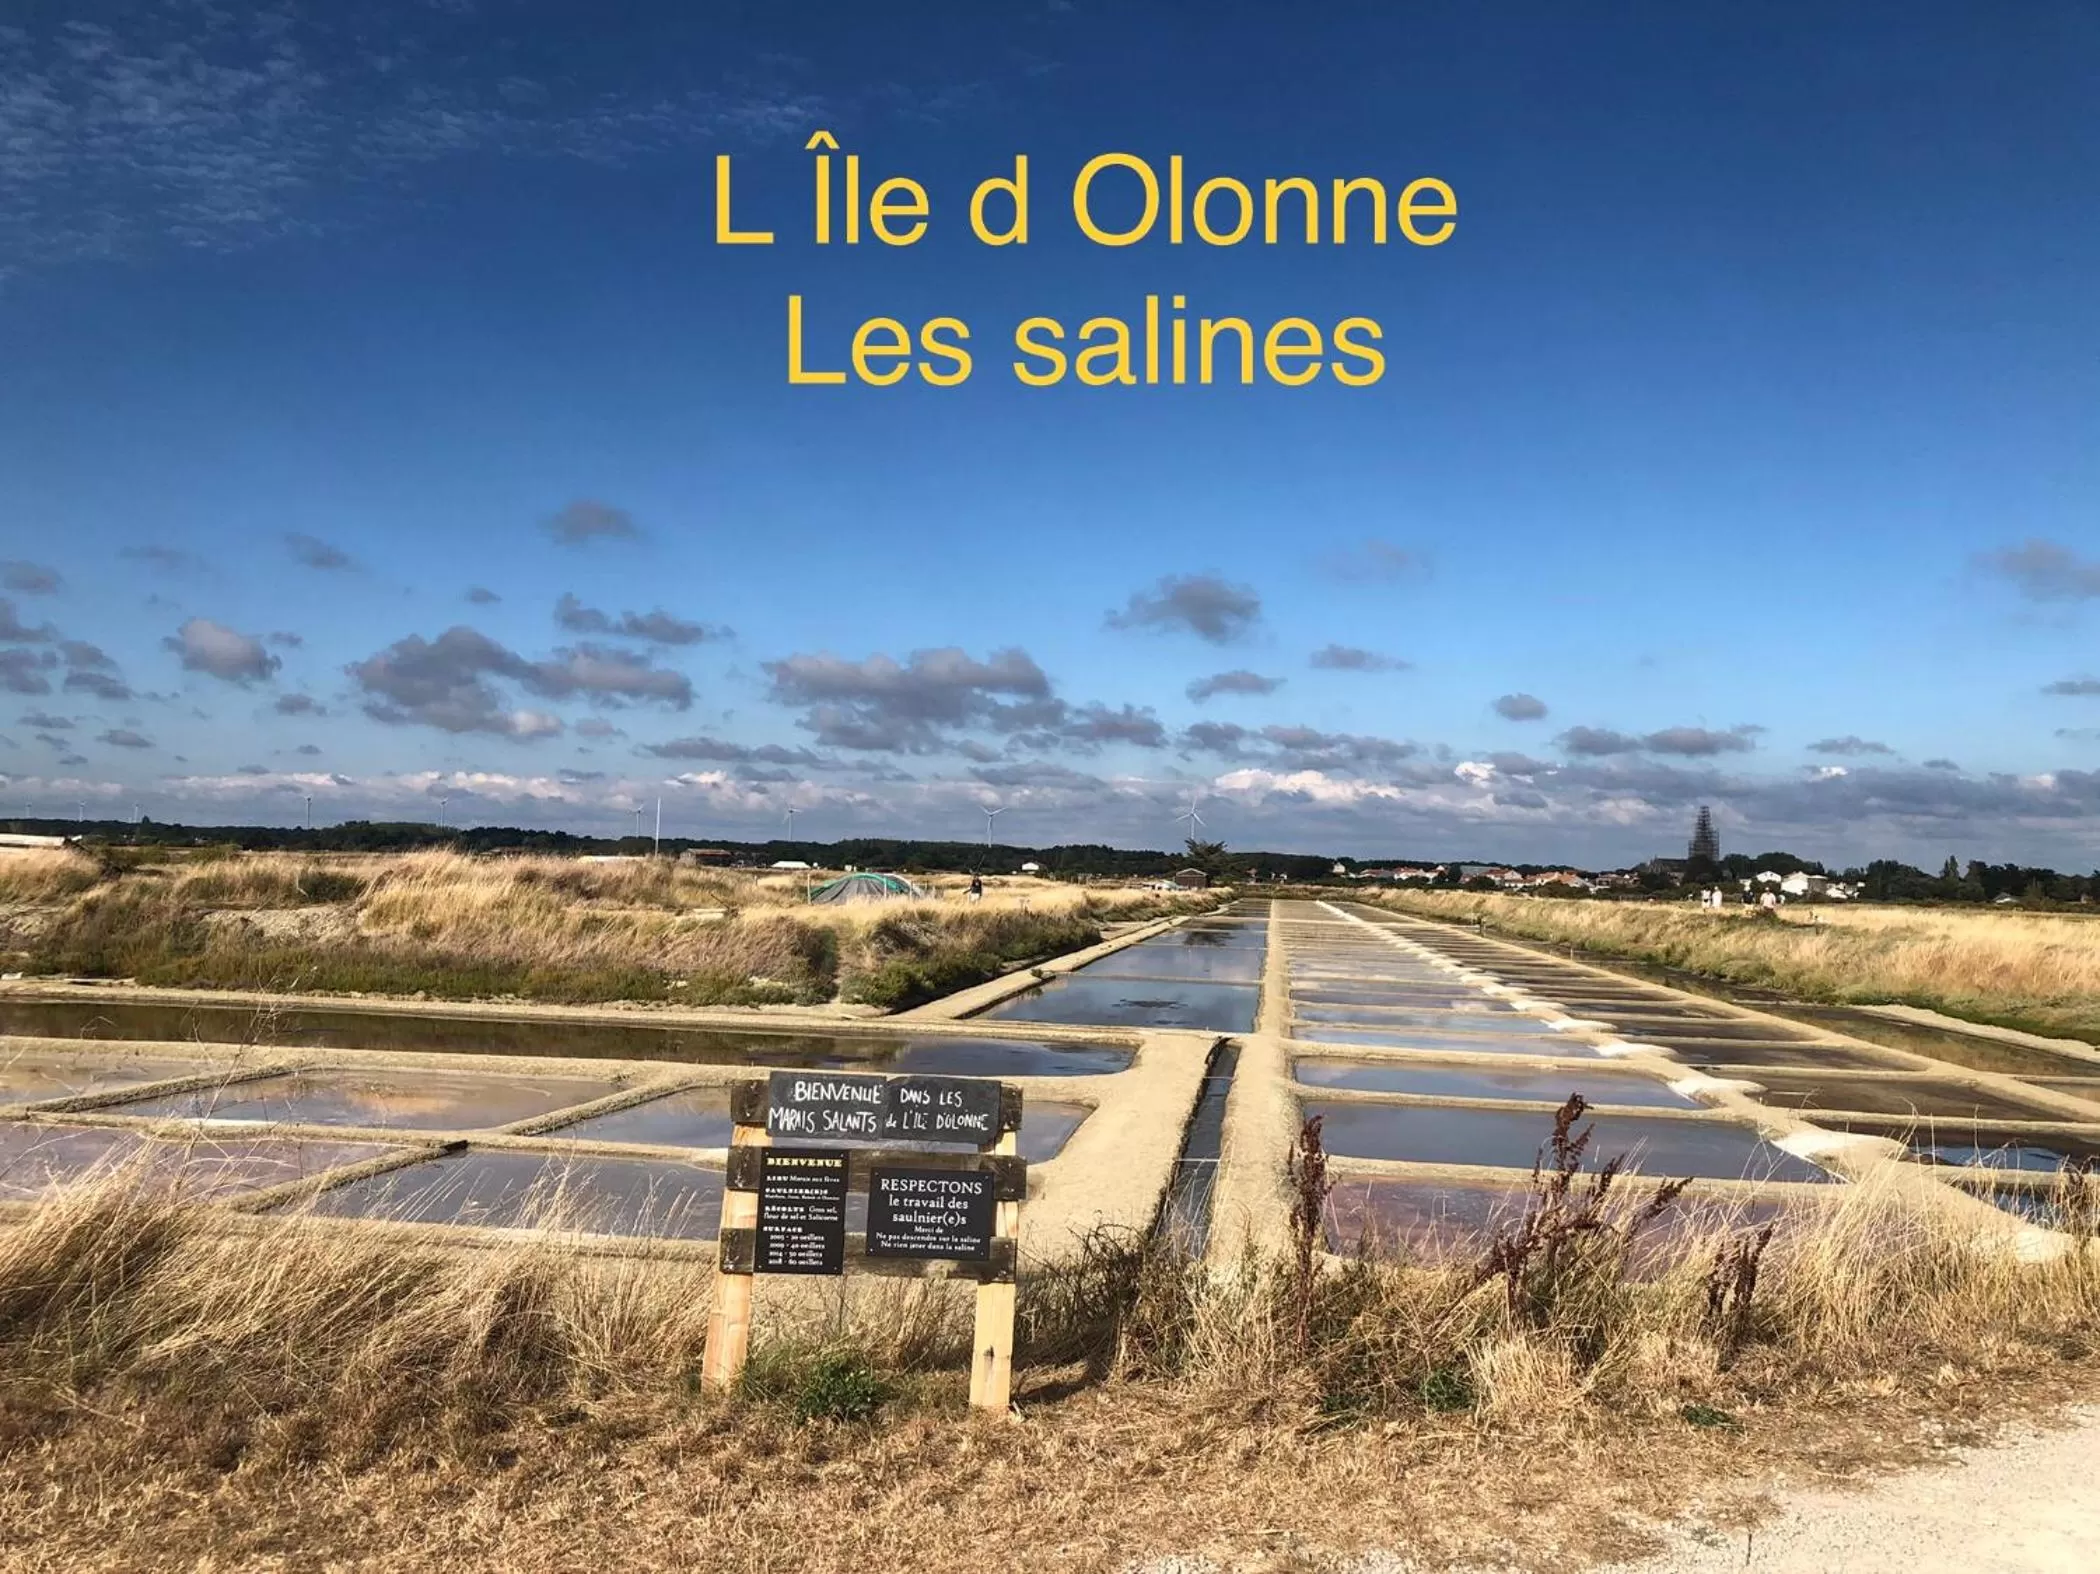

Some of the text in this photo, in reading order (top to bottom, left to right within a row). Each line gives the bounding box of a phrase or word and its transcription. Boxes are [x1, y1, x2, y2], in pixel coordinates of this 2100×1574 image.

[794, 1081, 962, 1108] BIENVENUE DANS LES
[768, 1107, 815, 1133] MARAIS
[822, 1109, 877, 1133] SALANTS
[766, 1157, 843, 1168] BIENVENUE
[880, 1178, 983, 1195] RESPECTONS
[888, 1193, 969, 1210] le travail des
[892, 1210, 967, 1227] saulnier(e)s
[875, 1232, 887, 1240] Ne
[901, 1233, 937, 1242] descendre
[935, 1226, 944, 1234] de
[880, 1240, 891, 1248] Ne
